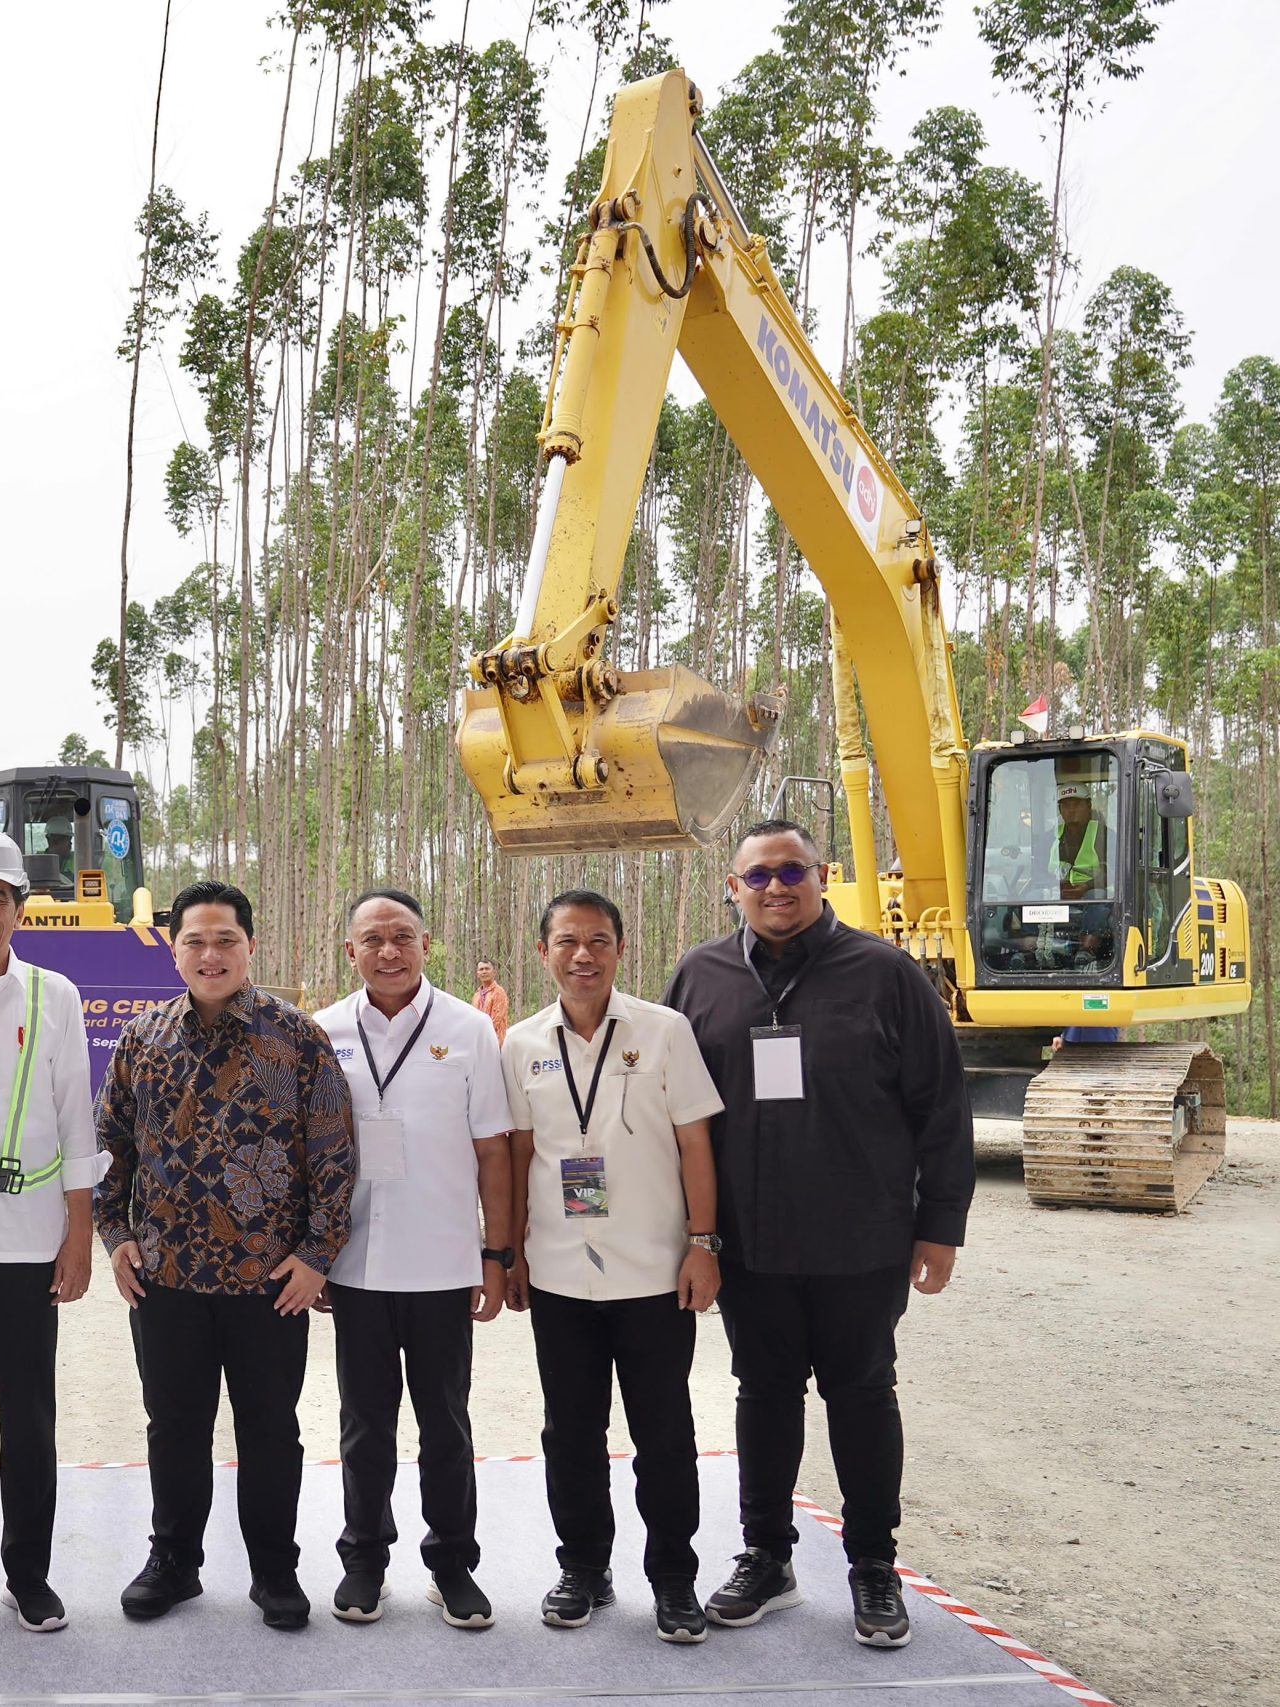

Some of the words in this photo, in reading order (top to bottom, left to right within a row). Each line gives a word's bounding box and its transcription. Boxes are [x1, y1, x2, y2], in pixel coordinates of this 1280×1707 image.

[756, 313, 855, 495] KOMATSU
[21, 915, 80, 927] ANTUI
[1200, 952, 1215, 976] 200
[81, 999, 109, 1014] G
[113, 999, 168, 1014] CEN
[84, 1017, 108, 1028] ard
[111, 1017, 128, 1028] Pr
[92, 1037, 118, 1050] Sep
[335, 1048, 354, 1058] PSSI
[542, 1059, 562, 1070] PSSI
[573, 1187, 596, 1198] VIP
